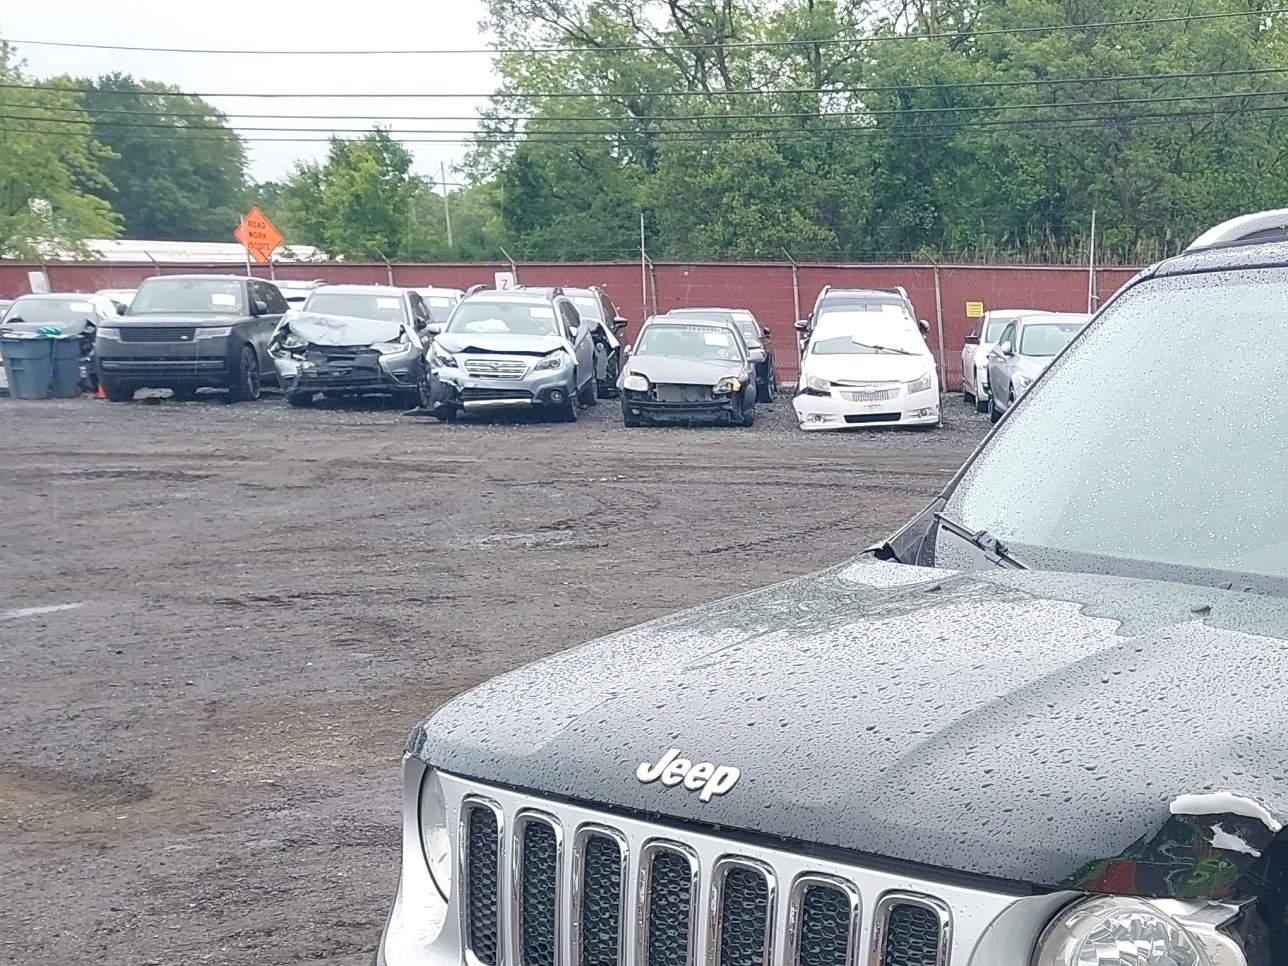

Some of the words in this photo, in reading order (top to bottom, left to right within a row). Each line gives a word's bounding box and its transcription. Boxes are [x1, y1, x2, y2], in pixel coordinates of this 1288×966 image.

[248, 220, 266, 229] ROAD
[248, 231, 267, 239] WORK
[636, 748, 741, 804] Jeep
